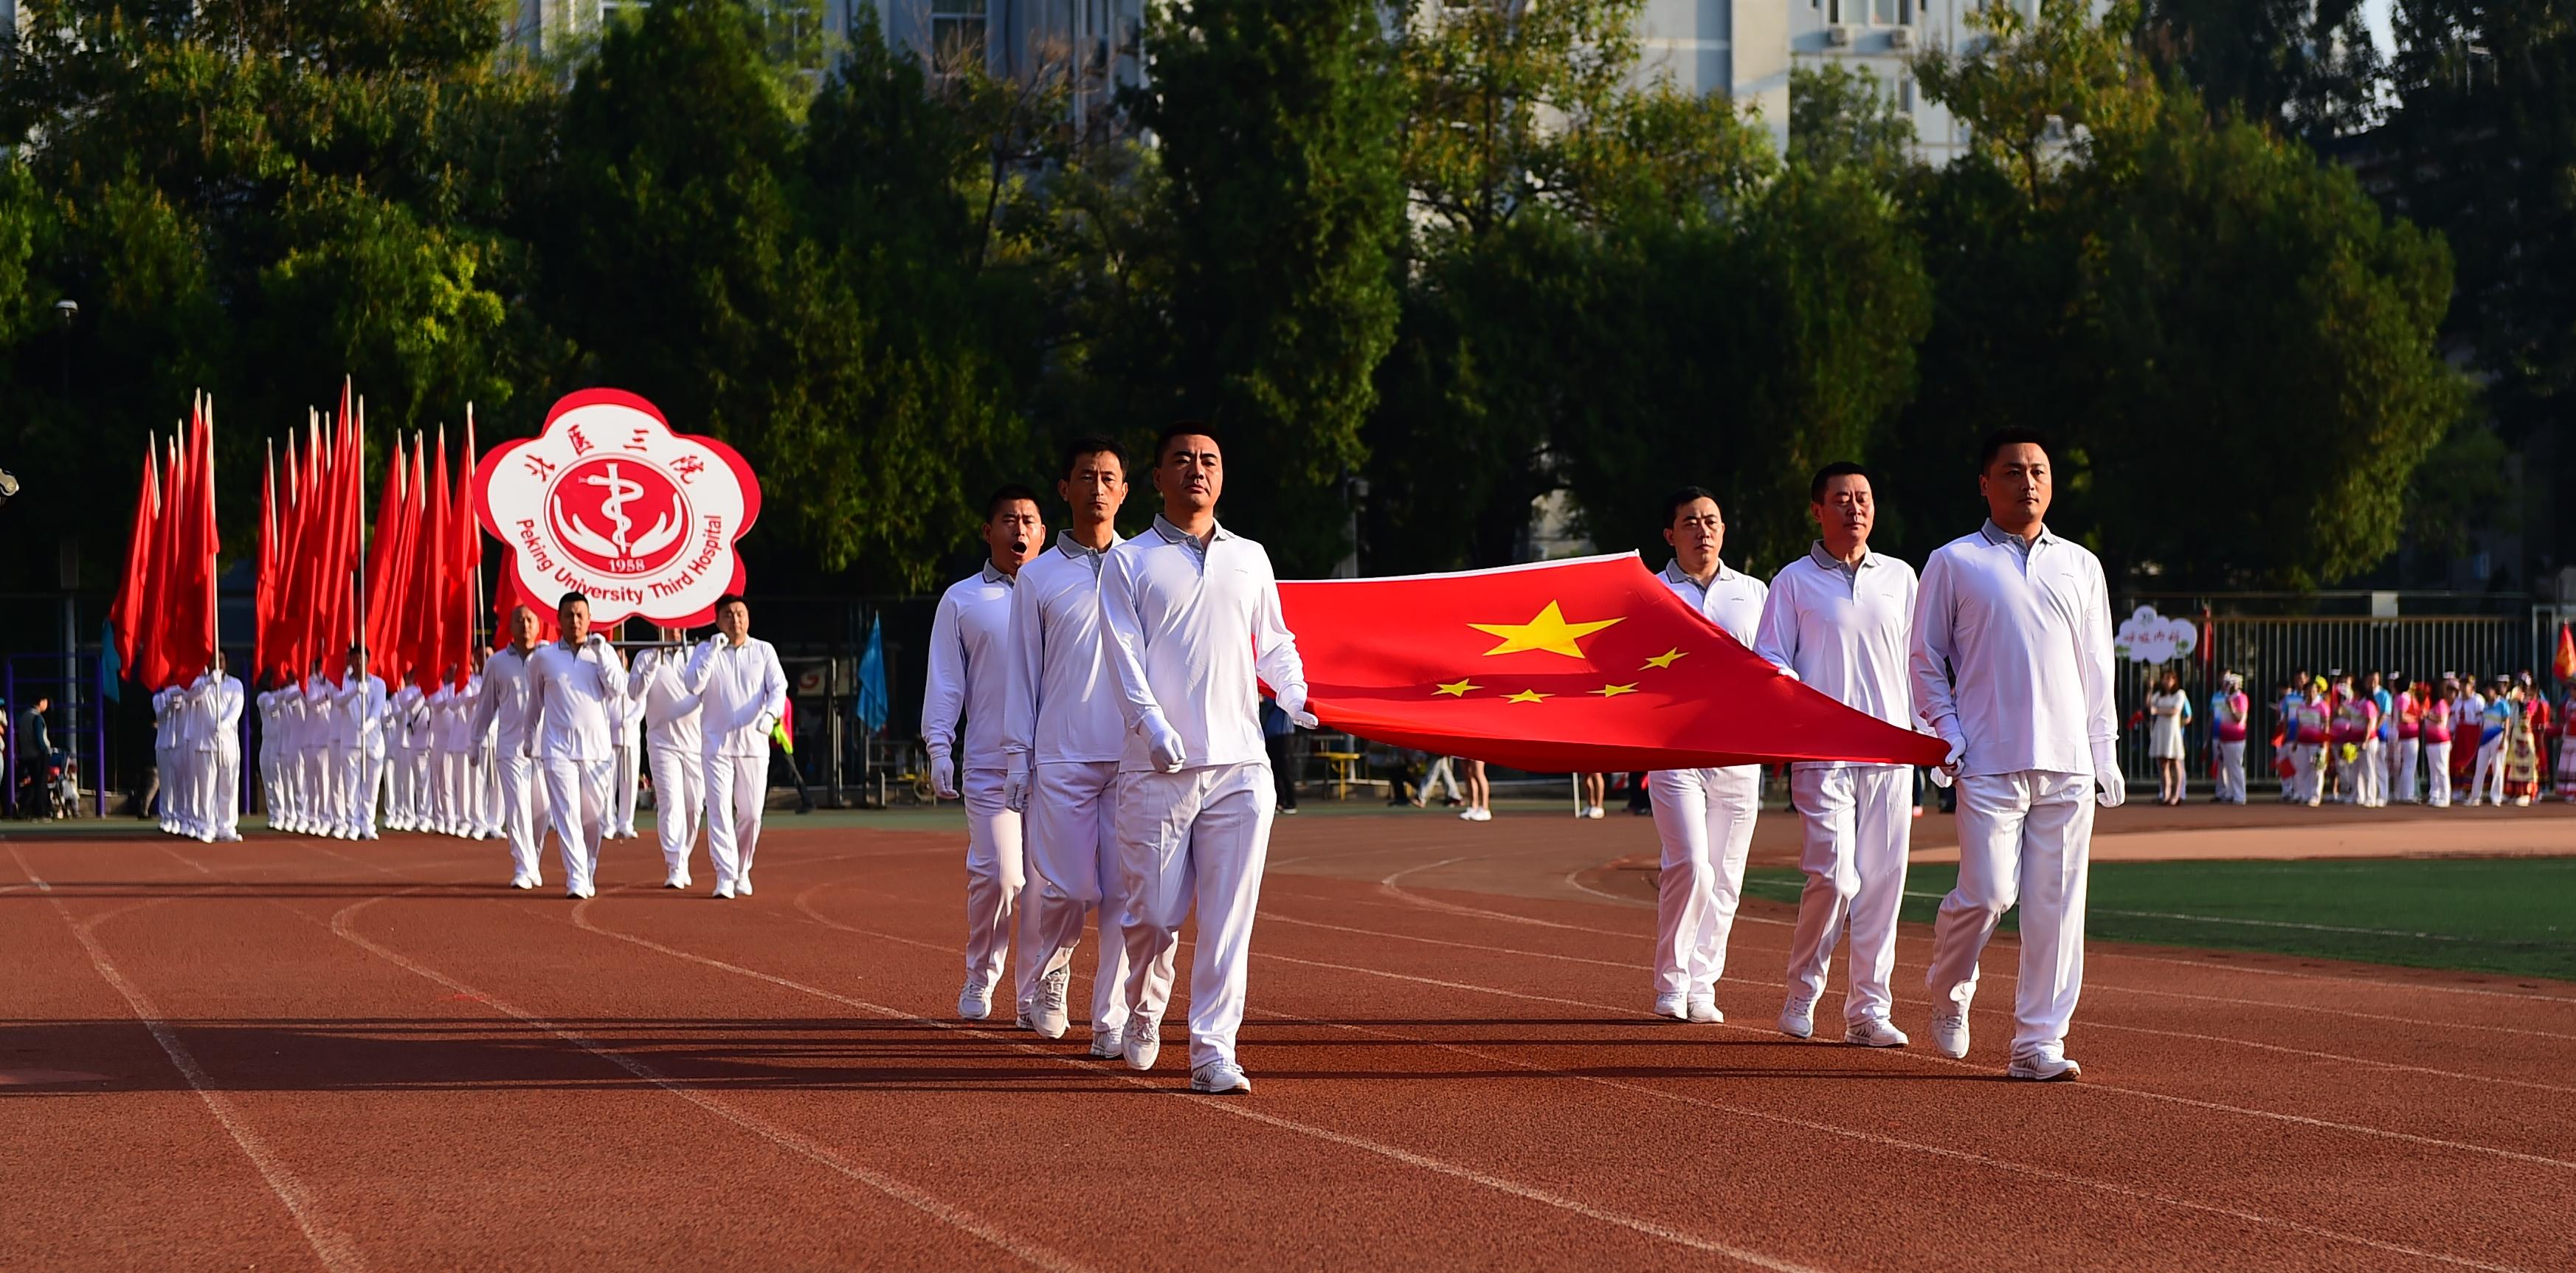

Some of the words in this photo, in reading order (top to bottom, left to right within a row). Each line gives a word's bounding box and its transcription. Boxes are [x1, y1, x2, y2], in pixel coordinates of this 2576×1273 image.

[525, 424, 704, 483] 北医三院
[516, 518, 553, 572] Peking
[554, 567, 643, 604] University
[648, 571, 695, 599] Third
[688, 514, 722, 576] Hospital
[609, 559, 646, 573] 1958
